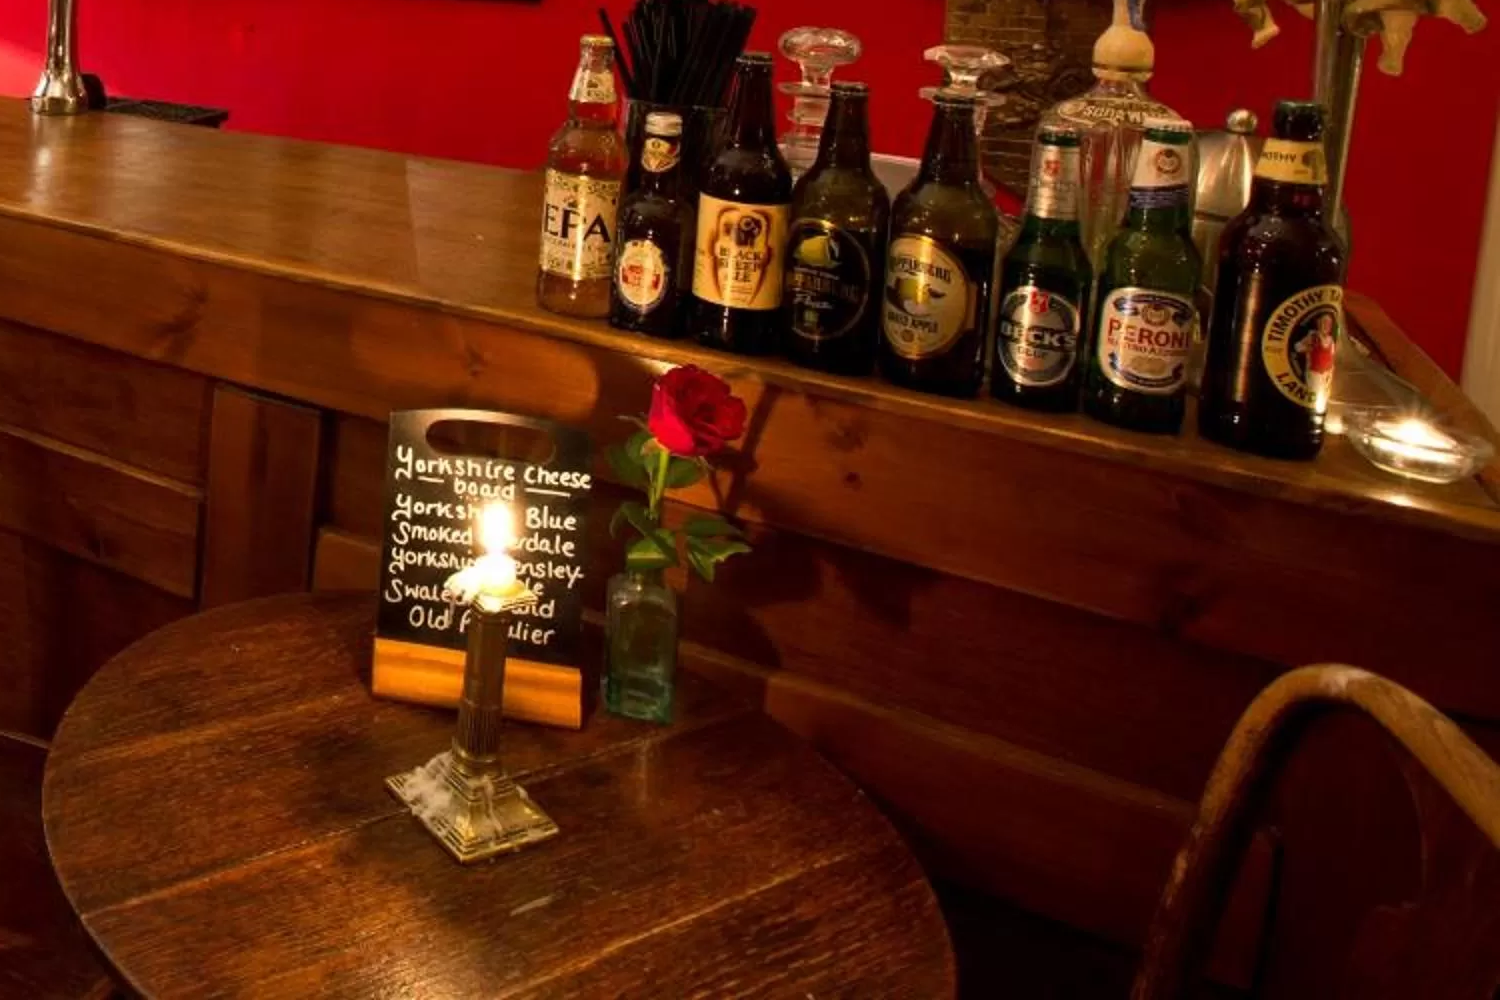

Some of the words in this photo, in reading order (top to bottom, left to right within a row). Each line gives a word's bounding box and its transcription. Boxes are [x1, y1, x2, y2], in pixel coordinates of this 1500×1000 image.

[719, 246, 762, 261] BACK
[1267, 289, 1323, 341] TIMOTHY
[1107, 317, 1190, 348] PERONI
[395, 445, 515, 480] Yorkshire
[523, 466, 592, 489] Cheese
[453, 478, 515, 498] board
[391, 493, 481, 521] Yorksh
[525, 506, 577, 531] Blue
[392, 521, 473, 545] Smoked
[514, 561, 585, 589] ensley-
[409, 605, 451, 631] Old
